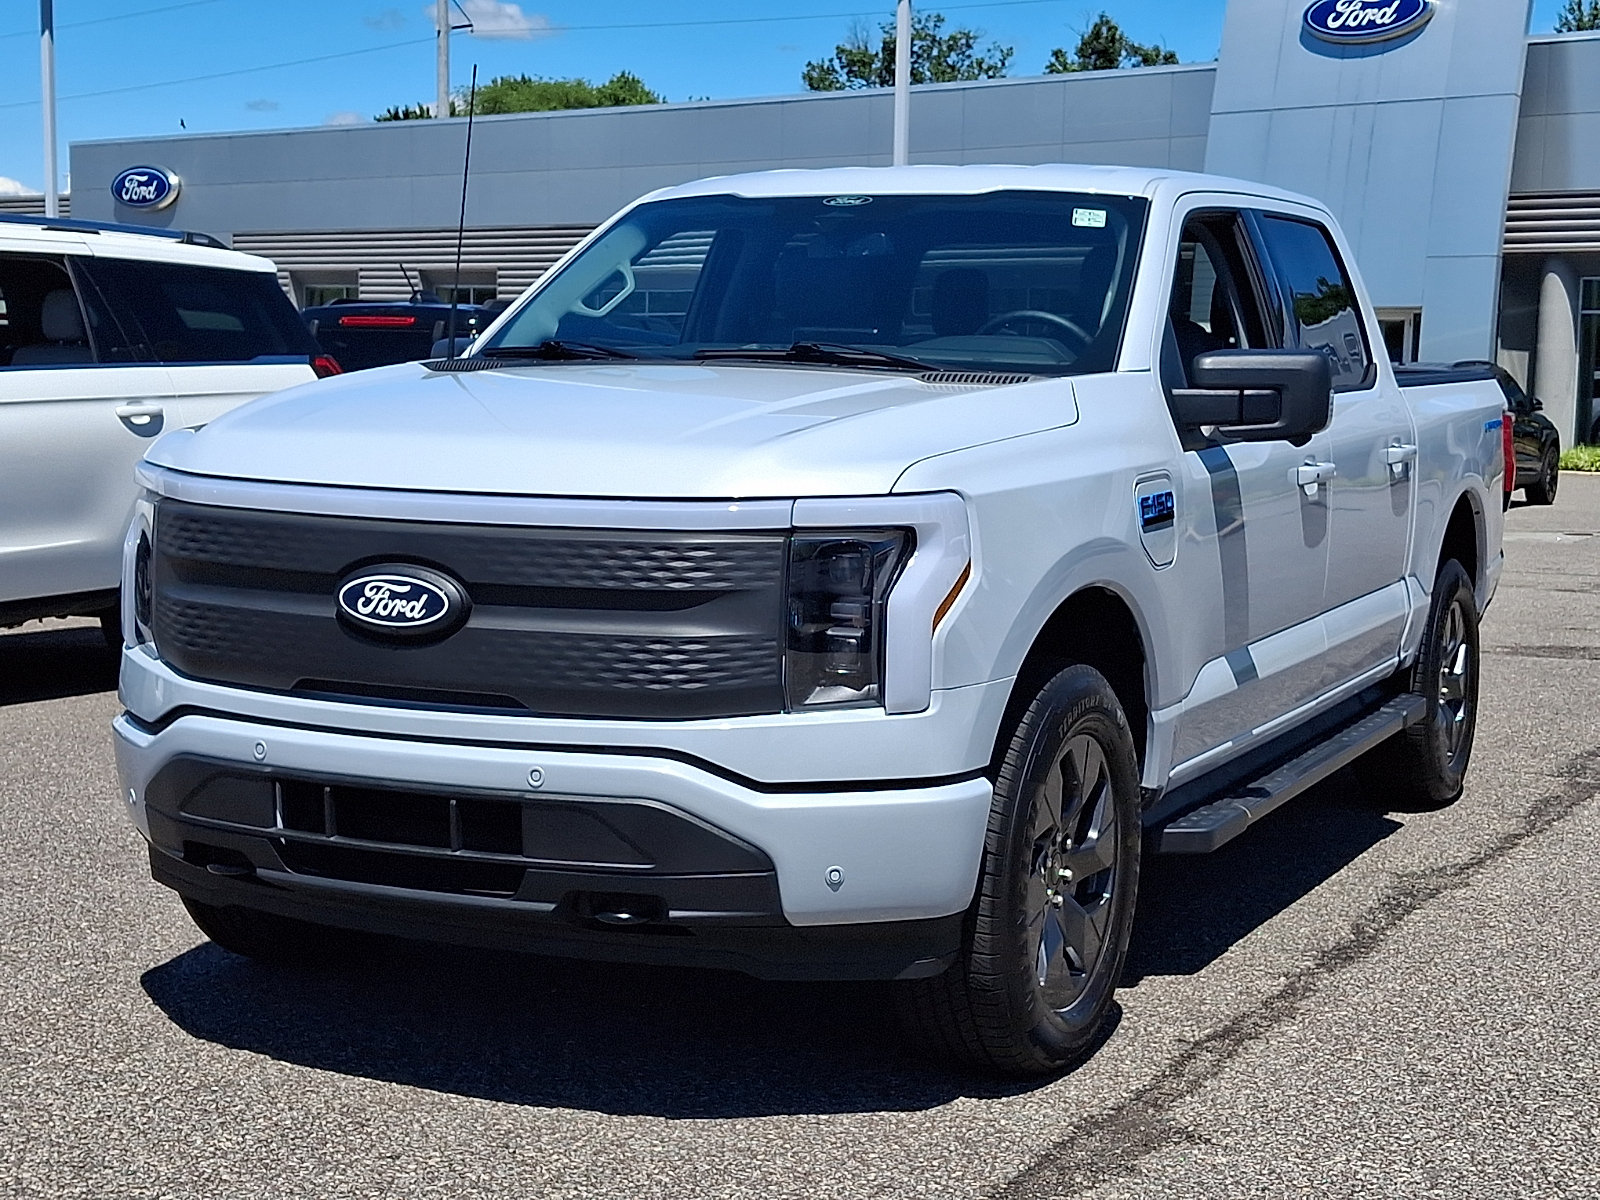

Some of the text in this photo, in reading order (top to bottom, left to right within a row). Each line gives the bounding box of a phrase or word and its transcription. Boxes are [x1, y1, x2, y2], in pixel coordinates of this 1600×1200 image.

[1326, 0, 1400, 28] Ford
[122, 175, 157, 200] Ford
[357, 581, 428, 619] Ford
